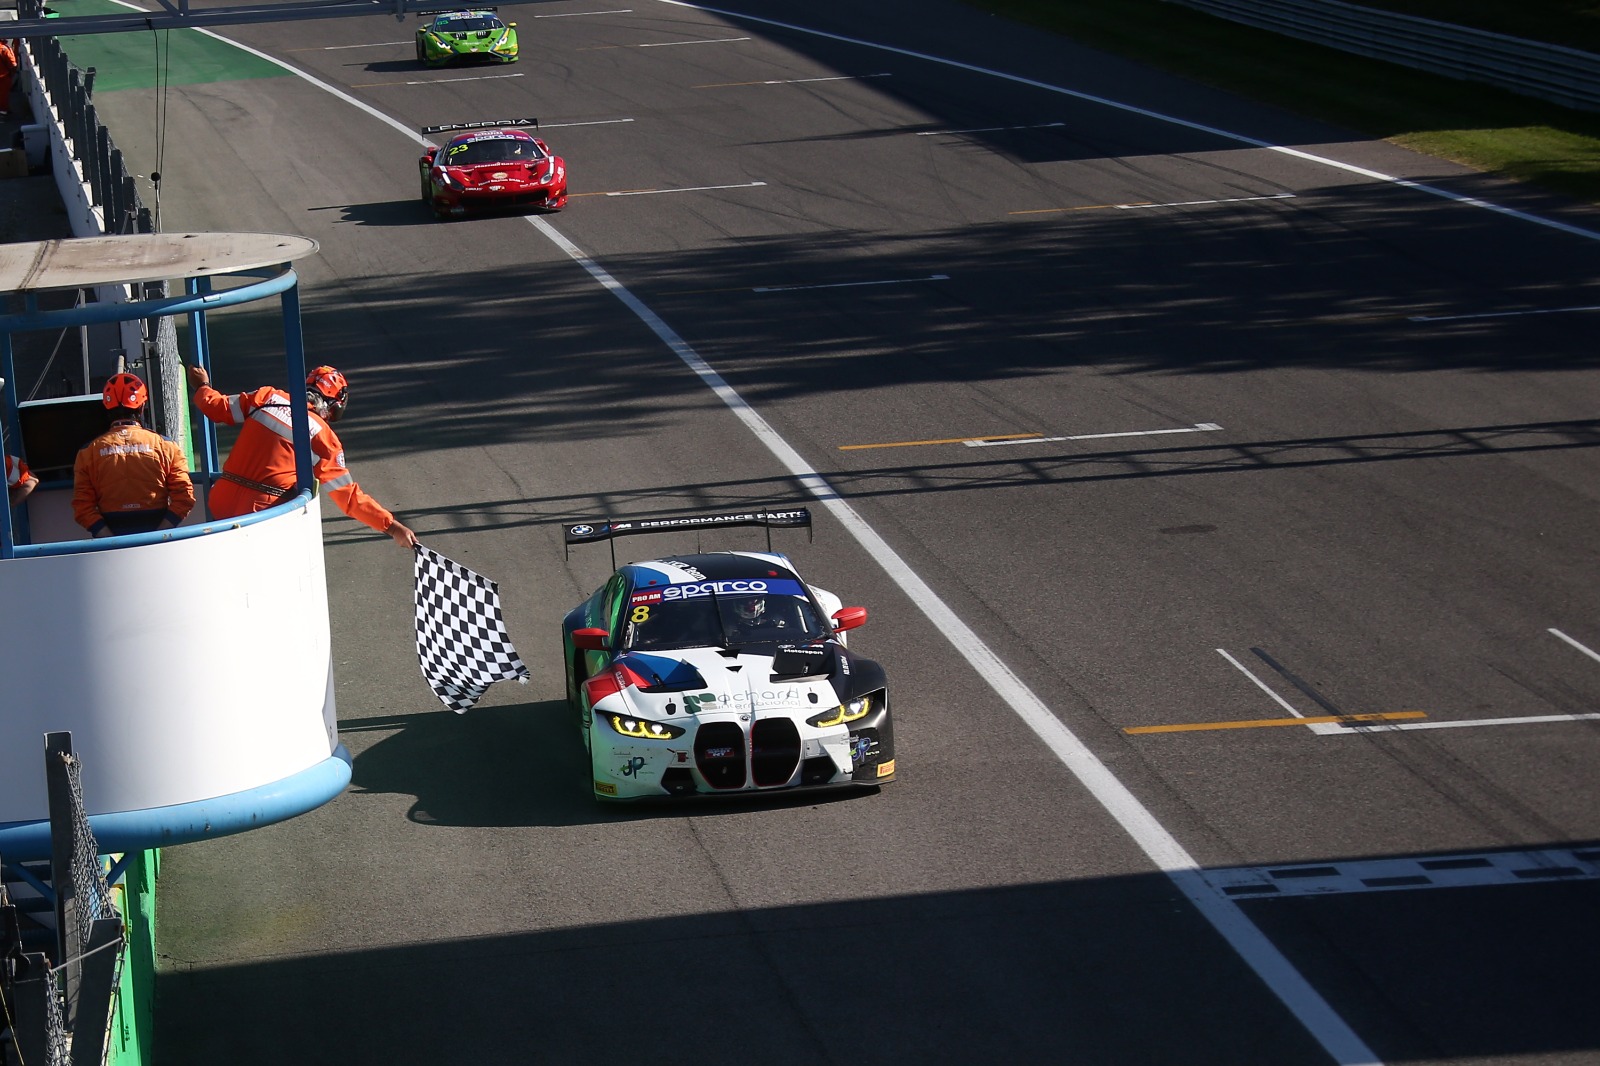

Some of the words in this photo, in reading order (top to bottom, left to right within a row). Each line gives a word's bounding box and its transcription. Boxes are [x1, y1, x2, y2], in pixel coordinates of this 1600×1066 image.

[449, 144, 468, 156] 23
[100, 443, 154, 456] MARSHAL
[641, 514, 754, 527] PERFORMANCE
[757, 511, 805, 519] PARTS
[663, 581, 768, 600] sparco
[632, 595, 643, 603] PRO
[631, 605, 650, 623] 8
